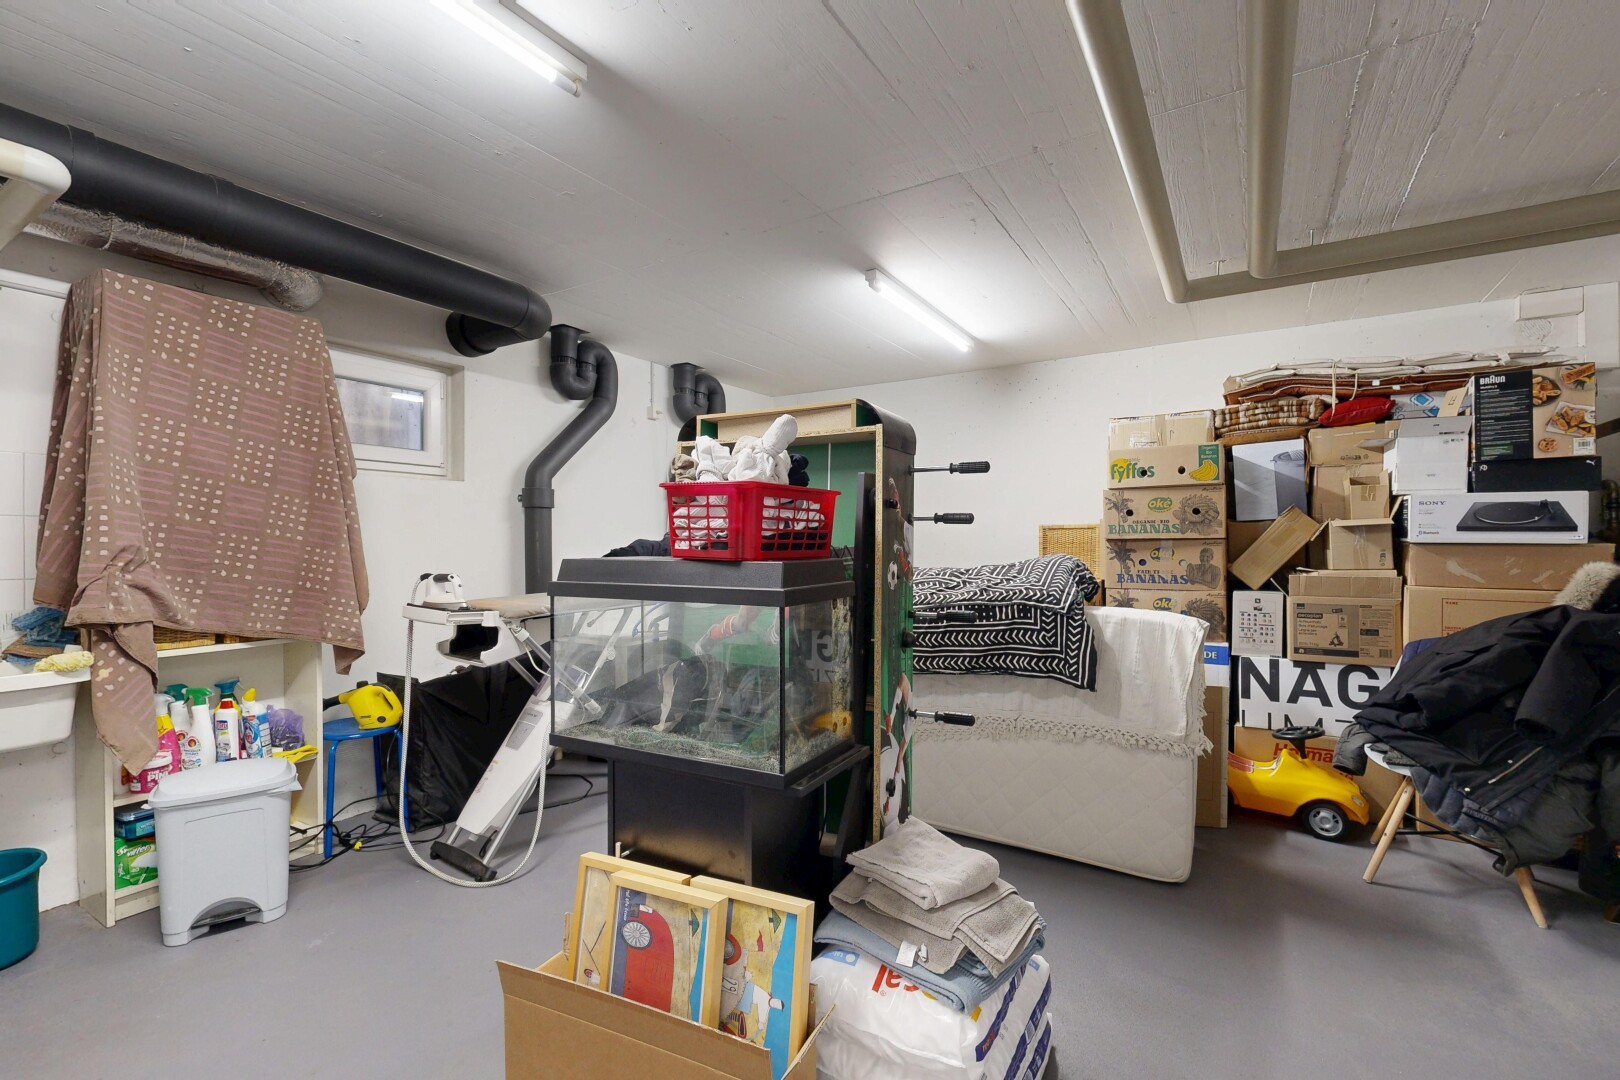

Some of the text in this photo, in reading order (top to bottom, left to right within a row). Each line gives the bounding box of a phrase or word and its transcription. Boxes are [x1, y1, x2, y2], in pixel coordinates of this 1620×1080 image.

[1480, 375, 1506, 385] BRAUN
[1108, 523, 1180, 535] BANANAS
[1116, 573, 1189, 585] BANANAS
